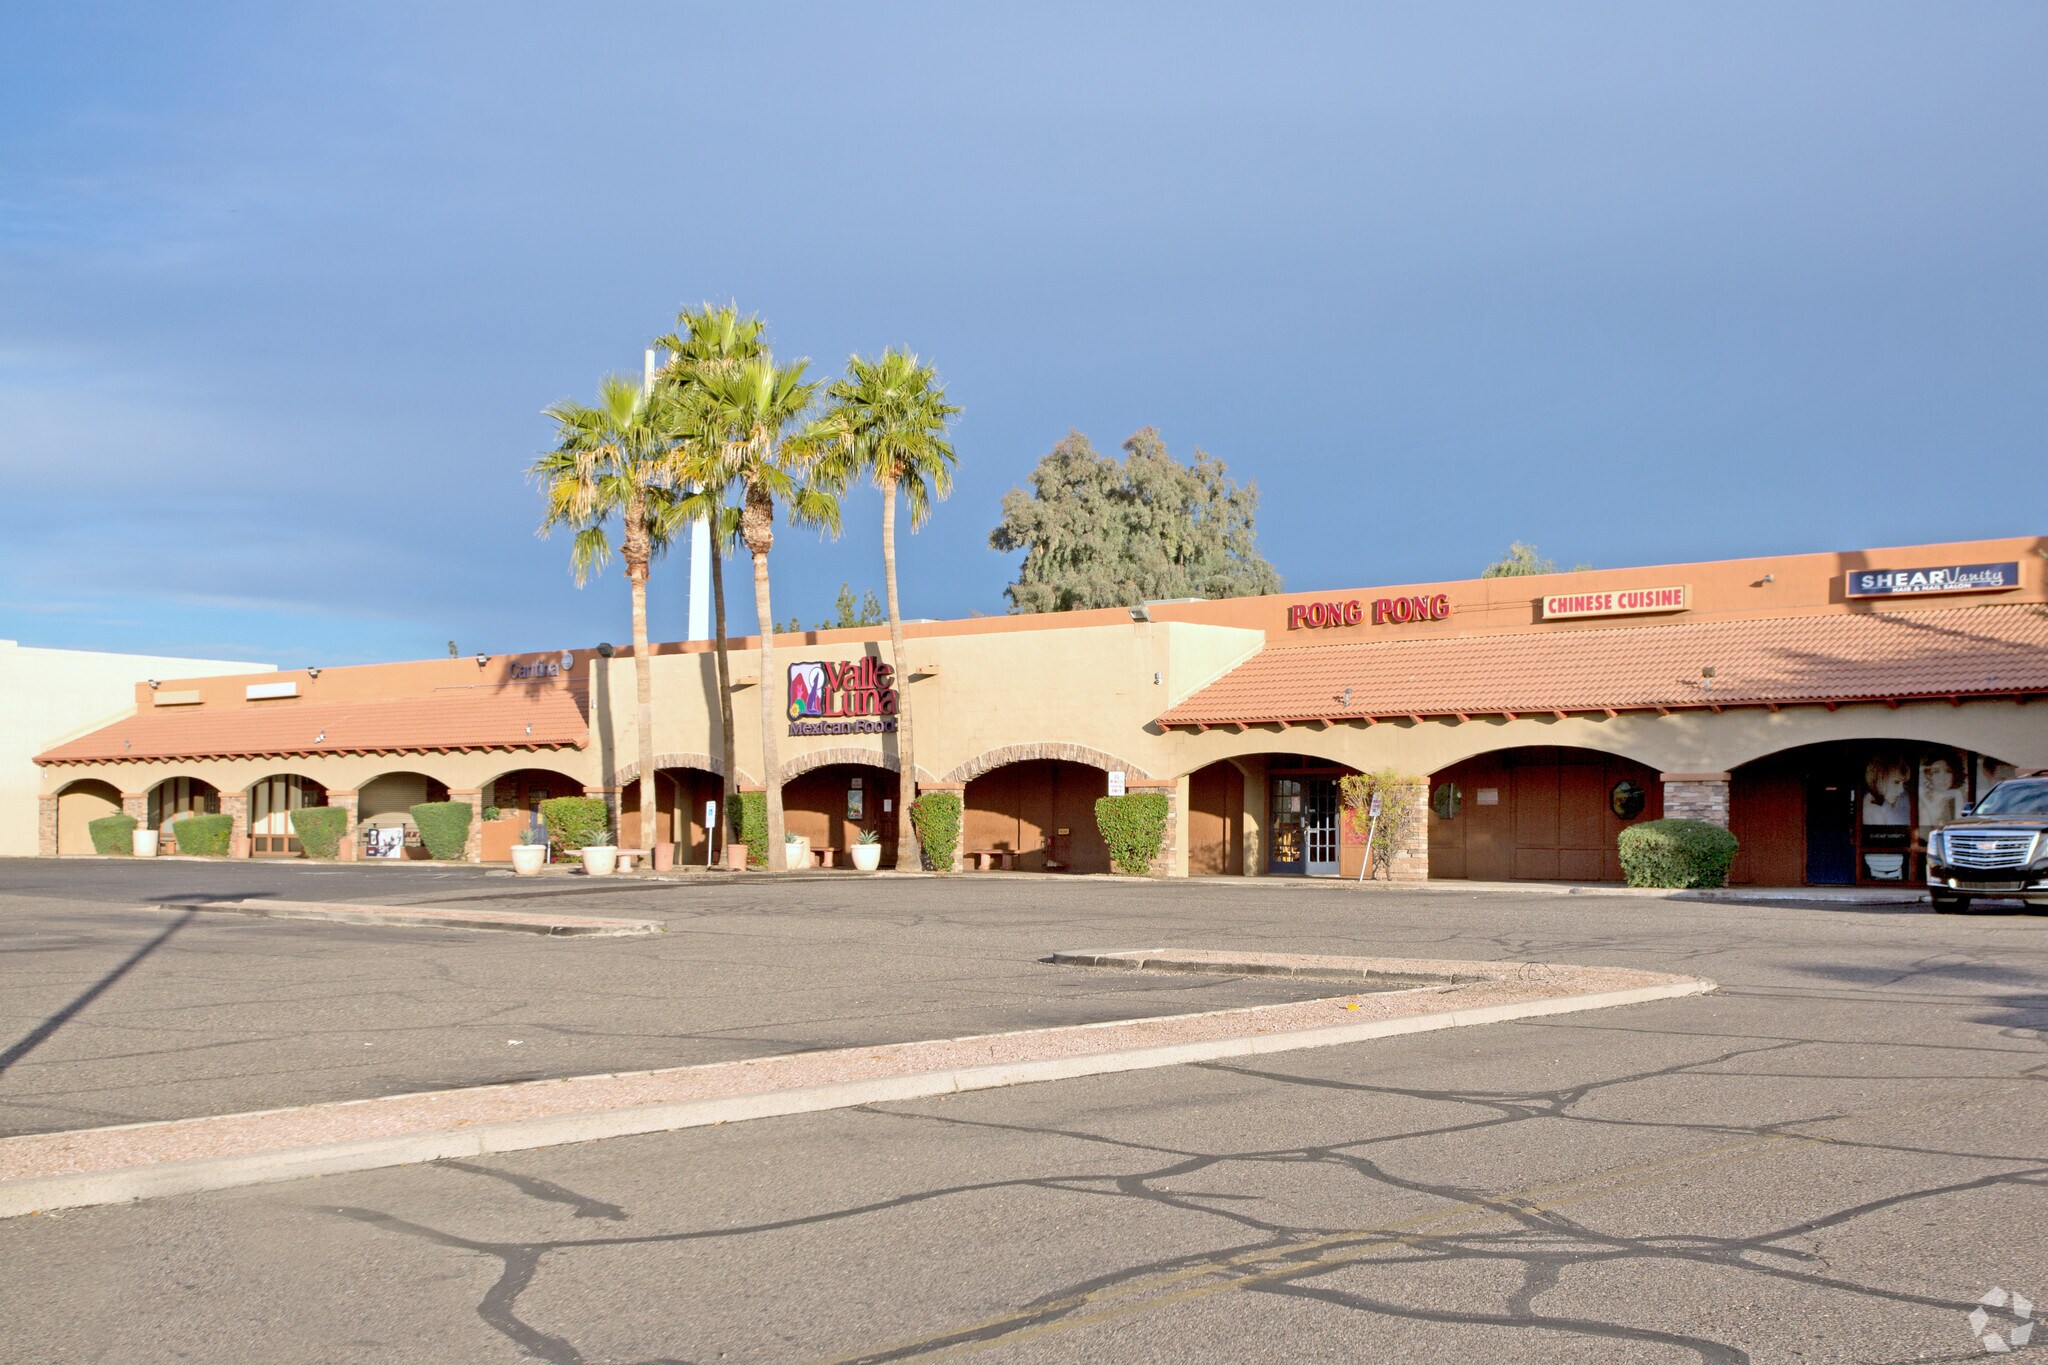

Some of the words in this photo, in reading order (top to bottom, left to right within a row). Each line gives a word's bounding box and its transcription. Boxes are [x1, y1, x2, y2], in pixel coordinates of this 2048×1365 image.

[1861, 570, 1944, 588] SHEAR
[1942, 567, 2004, 586] Vanity
[1291, 600, 1363, 628] PONG
[1376, 594, 1450, 622] PONG
[1548, 594, 1612, 614] CHINESE
[1617, 589, 1682, 609] CUISINE
[510, 660, 559, 679] Cantina
[823, 656, 895, 691] Valle
[823, 686, 899, 717] Luna
[789, 721, 851, 736] Mexican
[855, 718, 898, 734] Food
